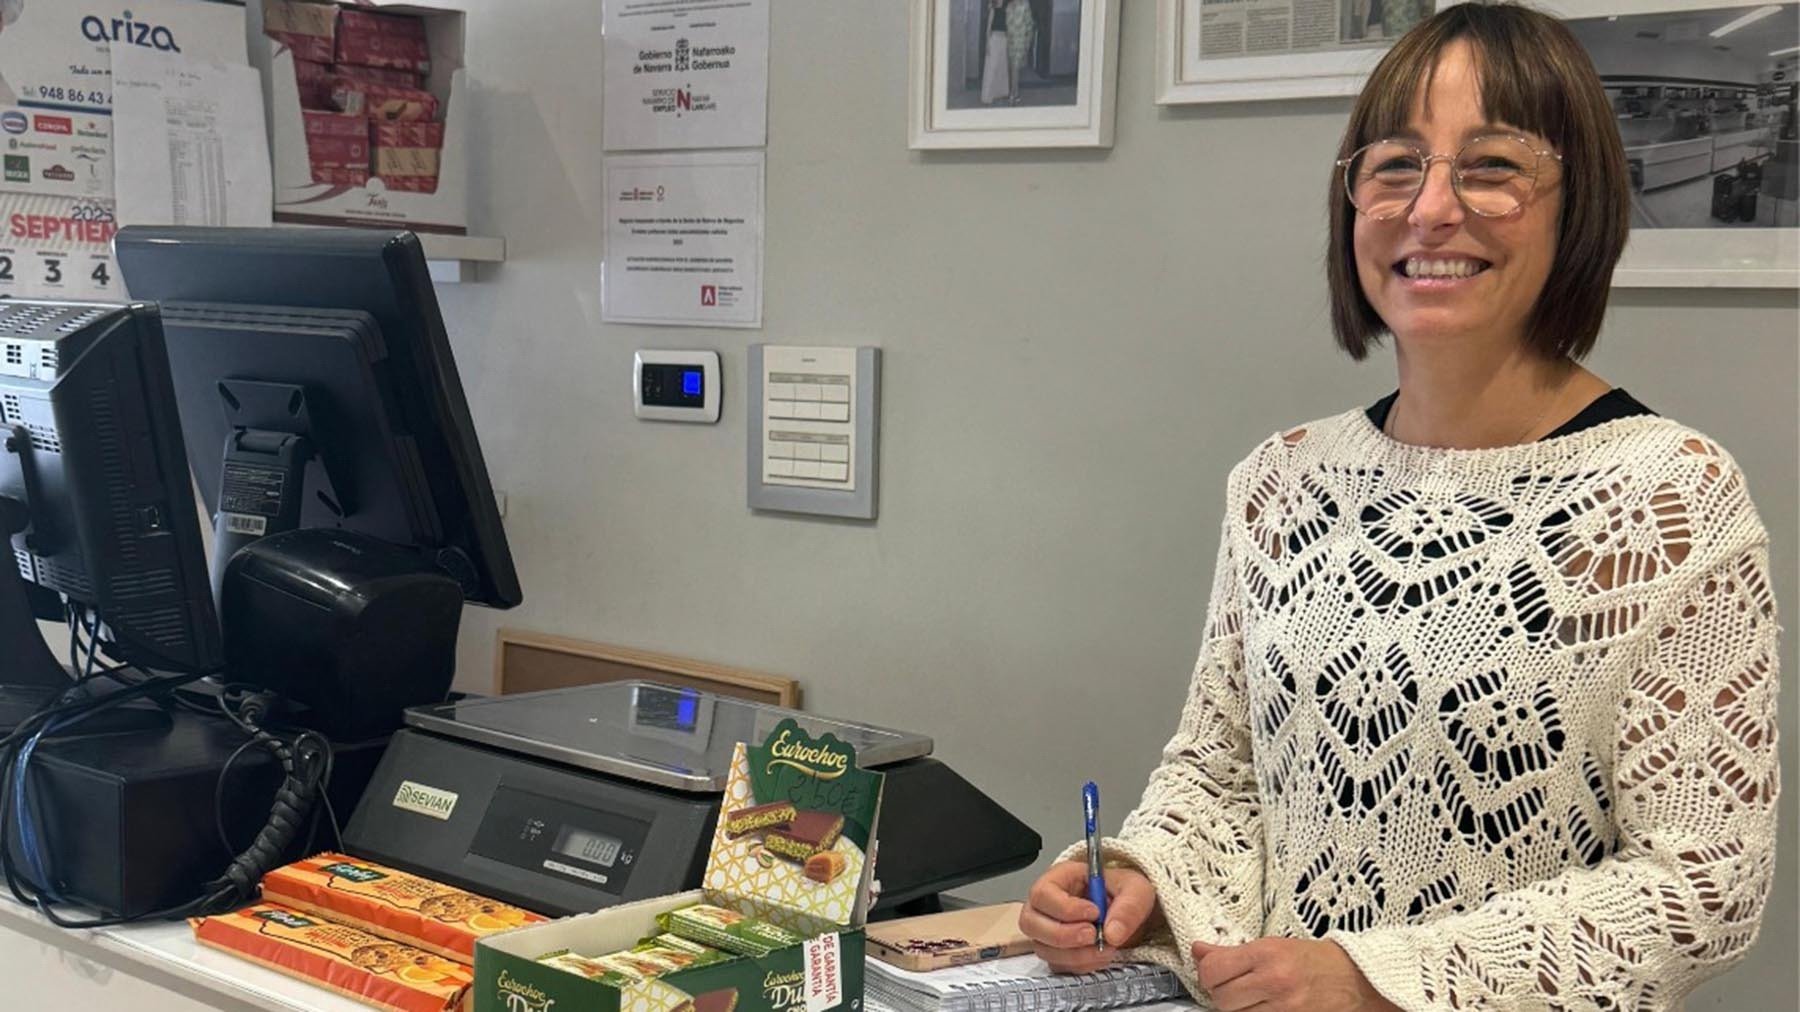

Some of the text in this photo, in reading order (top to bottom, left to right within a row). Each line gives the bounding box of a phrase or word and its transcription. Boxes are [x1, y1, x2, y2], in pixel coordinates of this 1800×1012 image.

[81, 9, 181, 54] ariza
[639, 50, 672, 61] Gobierno
[692, 46, 736, 57] Nafarroako
[633, 63, 672, 74] de Navarra
[691, 60, 730, 70] Gobernua
[39, 86, 64, 100] 948
[68, 88, 84, 102] 86
[88, 91, 104, 105] 43
[72, 206, 114, 223] 2025
[0, 256, 14, 280] 2
[45, 259, 62, 283] 3
[91, 262, 110, 286] 4
[771, 729, 848, 771] Eurochoc
[411, 790, 453, 812] SEVIAN
[620, 851, 634, 865] kg
[823, 935, 835, 951] DE
[497, 969, 546, 1001] Eurochoc
